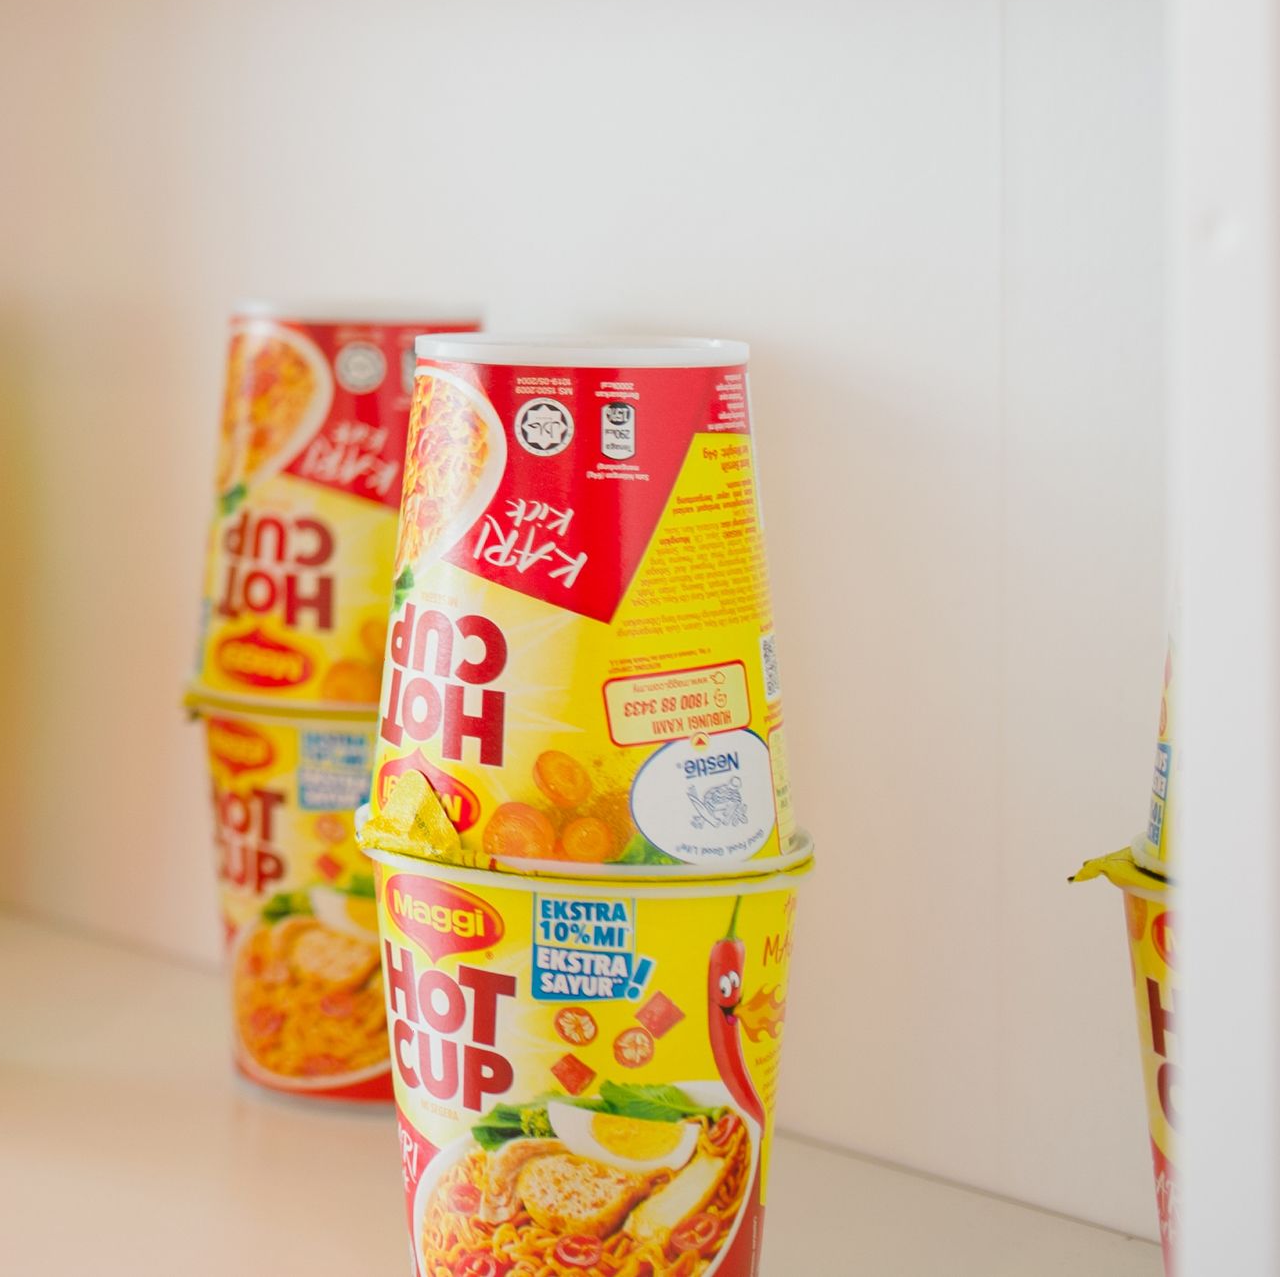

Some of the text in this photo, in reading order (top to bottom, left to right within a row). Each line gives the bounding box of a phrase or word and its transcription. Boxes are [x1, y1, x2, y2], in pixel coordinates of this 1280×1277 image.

[222, 511, 335, 567] CUP
[505, 498, 574, 536] Kick
[473, 514, 588, 589] KARI
[216, 565, 335, 632] HOT
[391, 602, 508, 686] CUP
[380, 667, 506, 767] HOT
[624, 692, 709, 717] 1800 88 3433
[652, 710, 731, 734] HUBUNGI KAMI
[684, 752, 739, 779] Nestlé
[393, 888, 486, 939] Maggi
[541, 899, 628, 922] EKSTRA
[537, 945, 628, 978] EKSTRA
[385, 938, 517, 1048] HOT
[394, 1019, 515, 1113] CUP
